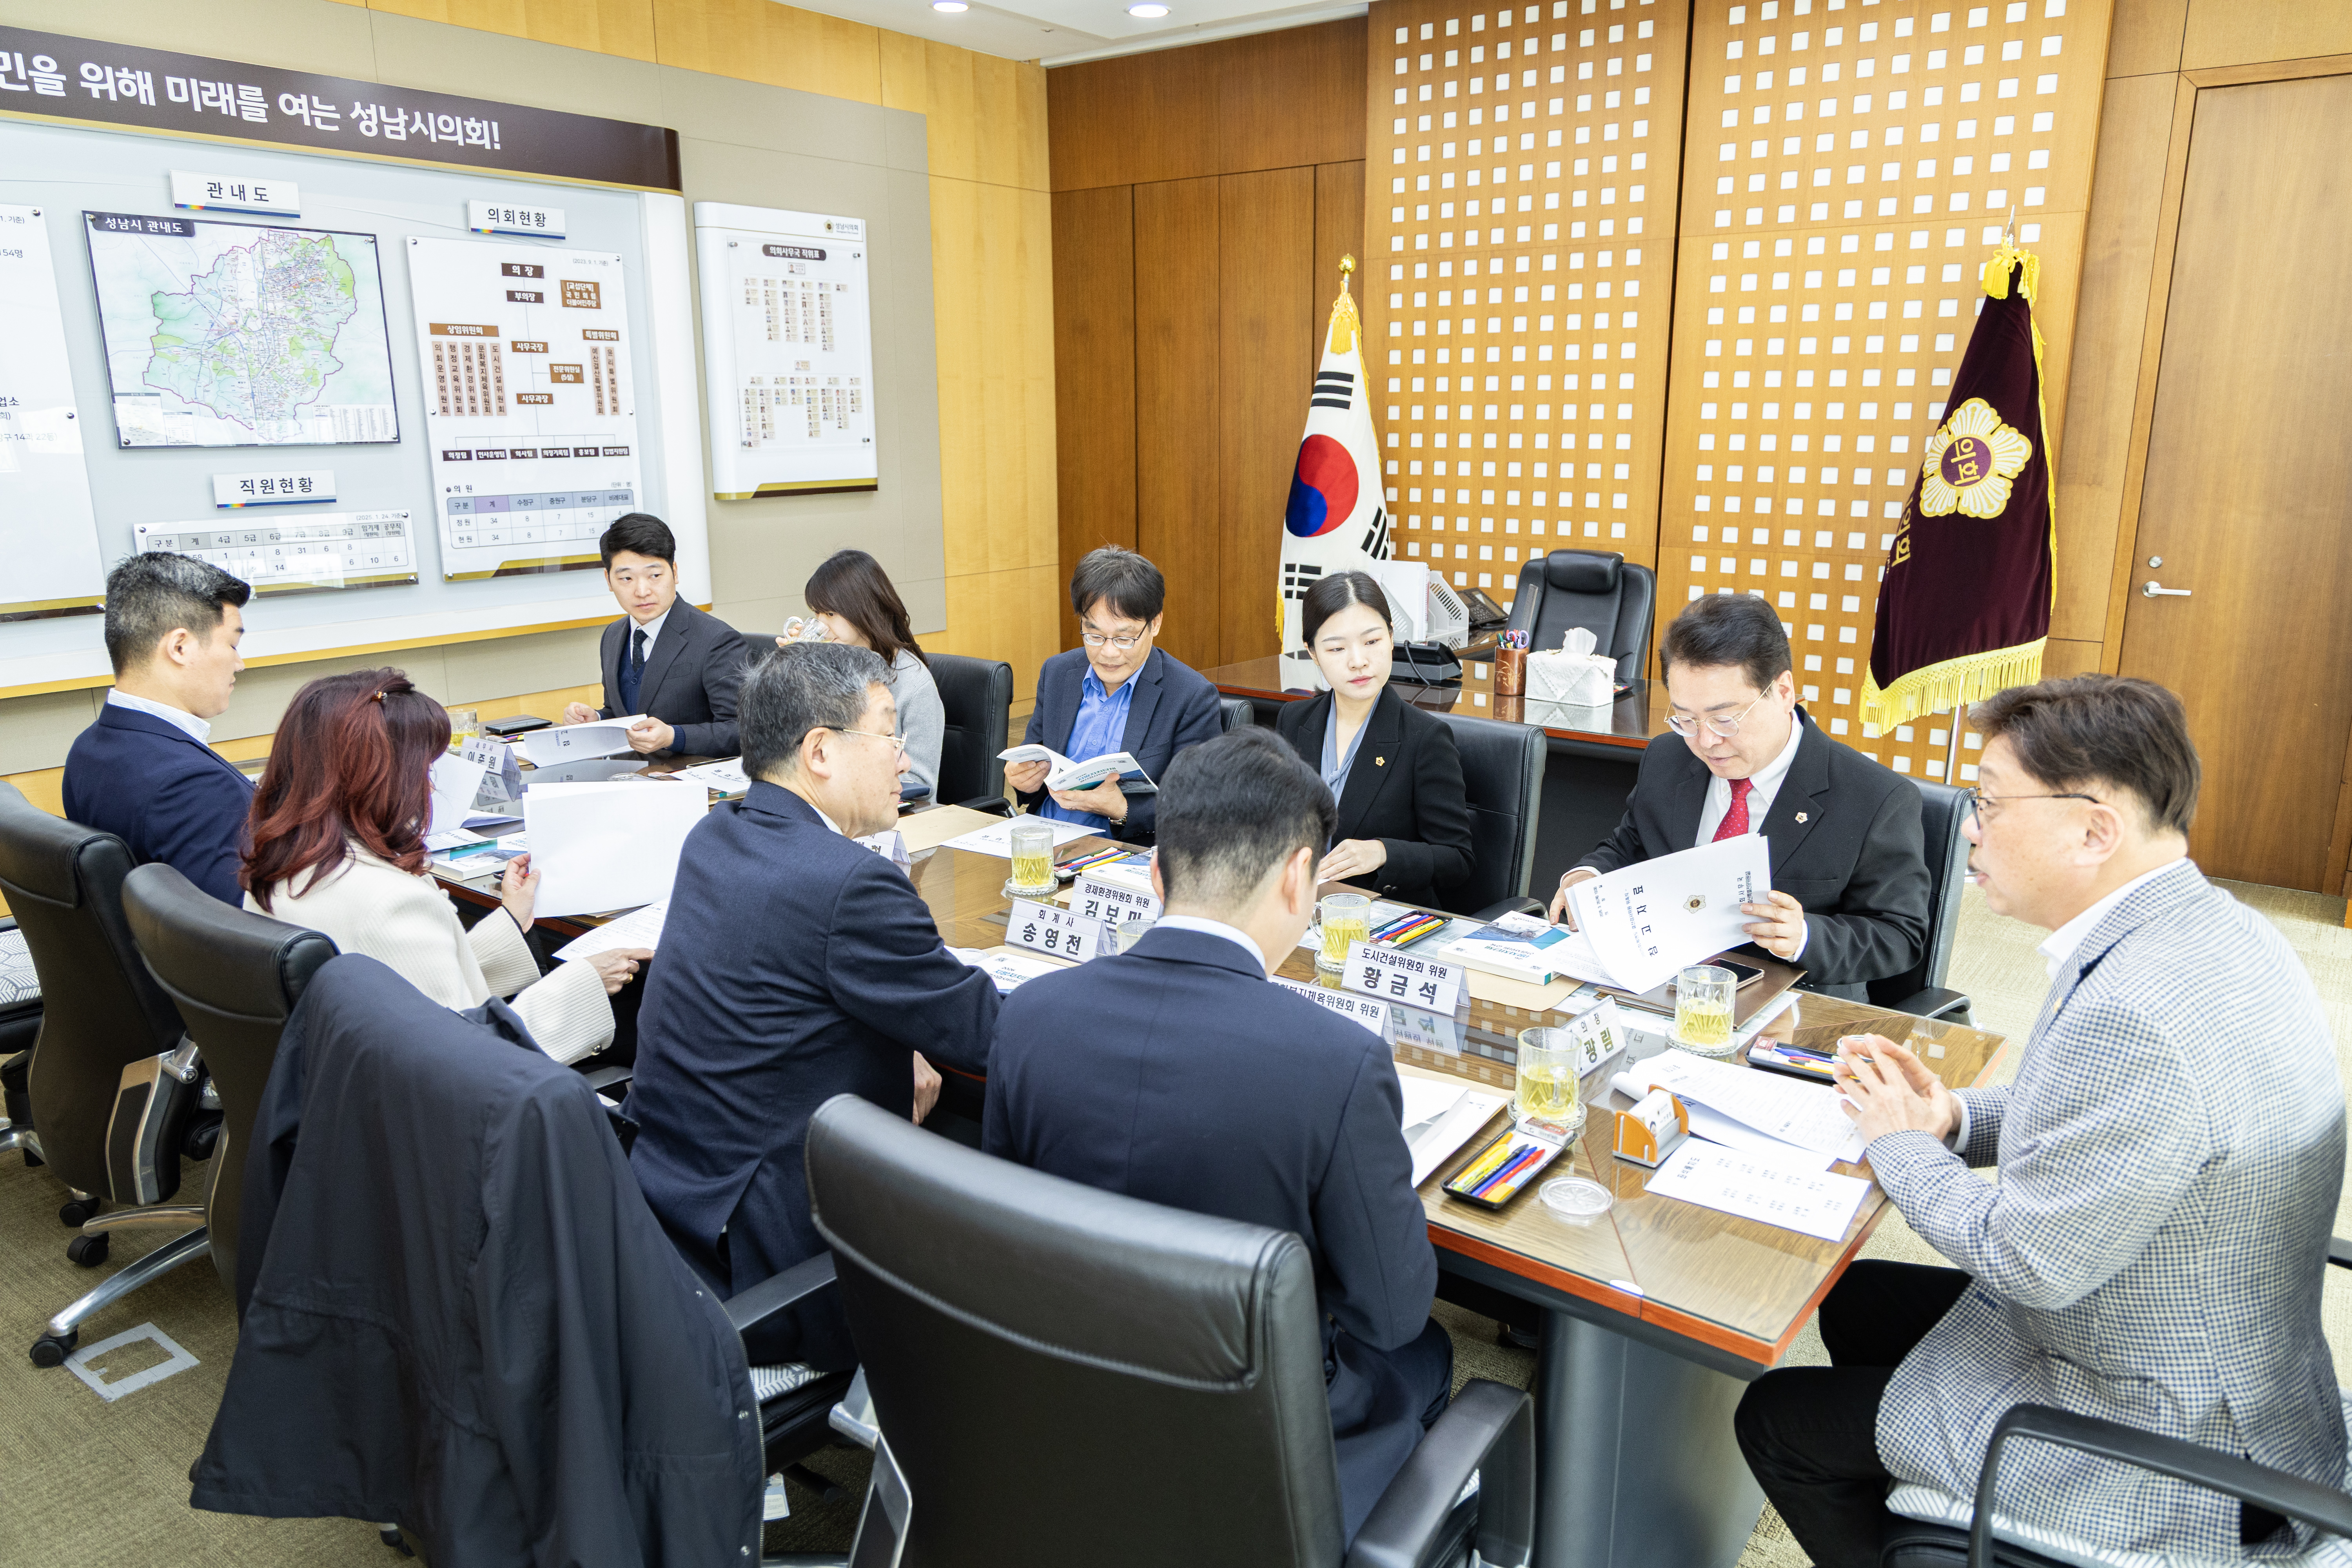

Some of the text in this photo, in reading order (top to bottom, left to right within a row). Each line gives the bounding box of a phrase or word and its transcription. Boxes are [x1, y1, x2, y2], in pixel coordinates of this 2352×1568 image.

[0, 52, 501, 150] 민을 위해 미래를 여는 성남시의회!
[105, 217, 183, 234] 성남시 관내도
[488, 207, 546, 227] 의회현황
[0, 249, 23, 258] 54명
[769, 246, 820, 259] 의회사무국 직위표
[566, 282, 594, 292] [교섭단체]
[515, 292, 536, 302] 부의장
[566, 299, 597, 307] 더불어민주당
[447, 325, 483, 335] 상임위원회
[585, 330, 617, 340] 특별위원회
[516, 342, 544, 352] 사무국장
[552, 365, 581, 374] 전문위원실
[560, 373, 575, 382] (5실)
[434, 344, 448, 414] 의회운영위원회
[449, 344, 463, 413] 행정교육위원회
[464, 345, 477, 413] 경제환경위원회
[492, 346, 505, 413] 도시건설위원회
[521, 394, 548, 404] 사무과장
[477, 450, 505, 459] 인사운영팀
[543, 448, 568, 457] 의정기록팀
[578, 448, 595, 456] 홍보팀
[604, 447, 628, 456] 입법지원팀
[1951, 439, 1980, 485] 의회
[240, 477, 313, 495] 직원현황
[517, 498, 534, 506] 수정구
[456, 519, 470, 527] 정원
[1891, 497, 1913, 567] 의회
[154, 539, 173, 548] 구분
[218, 535, 231, 544] 4급
[1085, 884, 1150, 908] 경제환경위원회 위원
[1737, 877, 1745, 902] 회사무국
[1038, 909, 1074, 928] 회계사
[1633, 885, 1658, 957] 참고자료
[1023, 922, 1082, 956] 송영천
[1361, 947, 1448, 980] 도시건설위원회 위원
[1363, 965, 1437, 1005] 황금석
[1272, 981, 1379, 1018] 지체육위원회 위원
[1581, 1013, 1601, 1033] 의장
[1580, 1027, 1615, 1072] 광림
